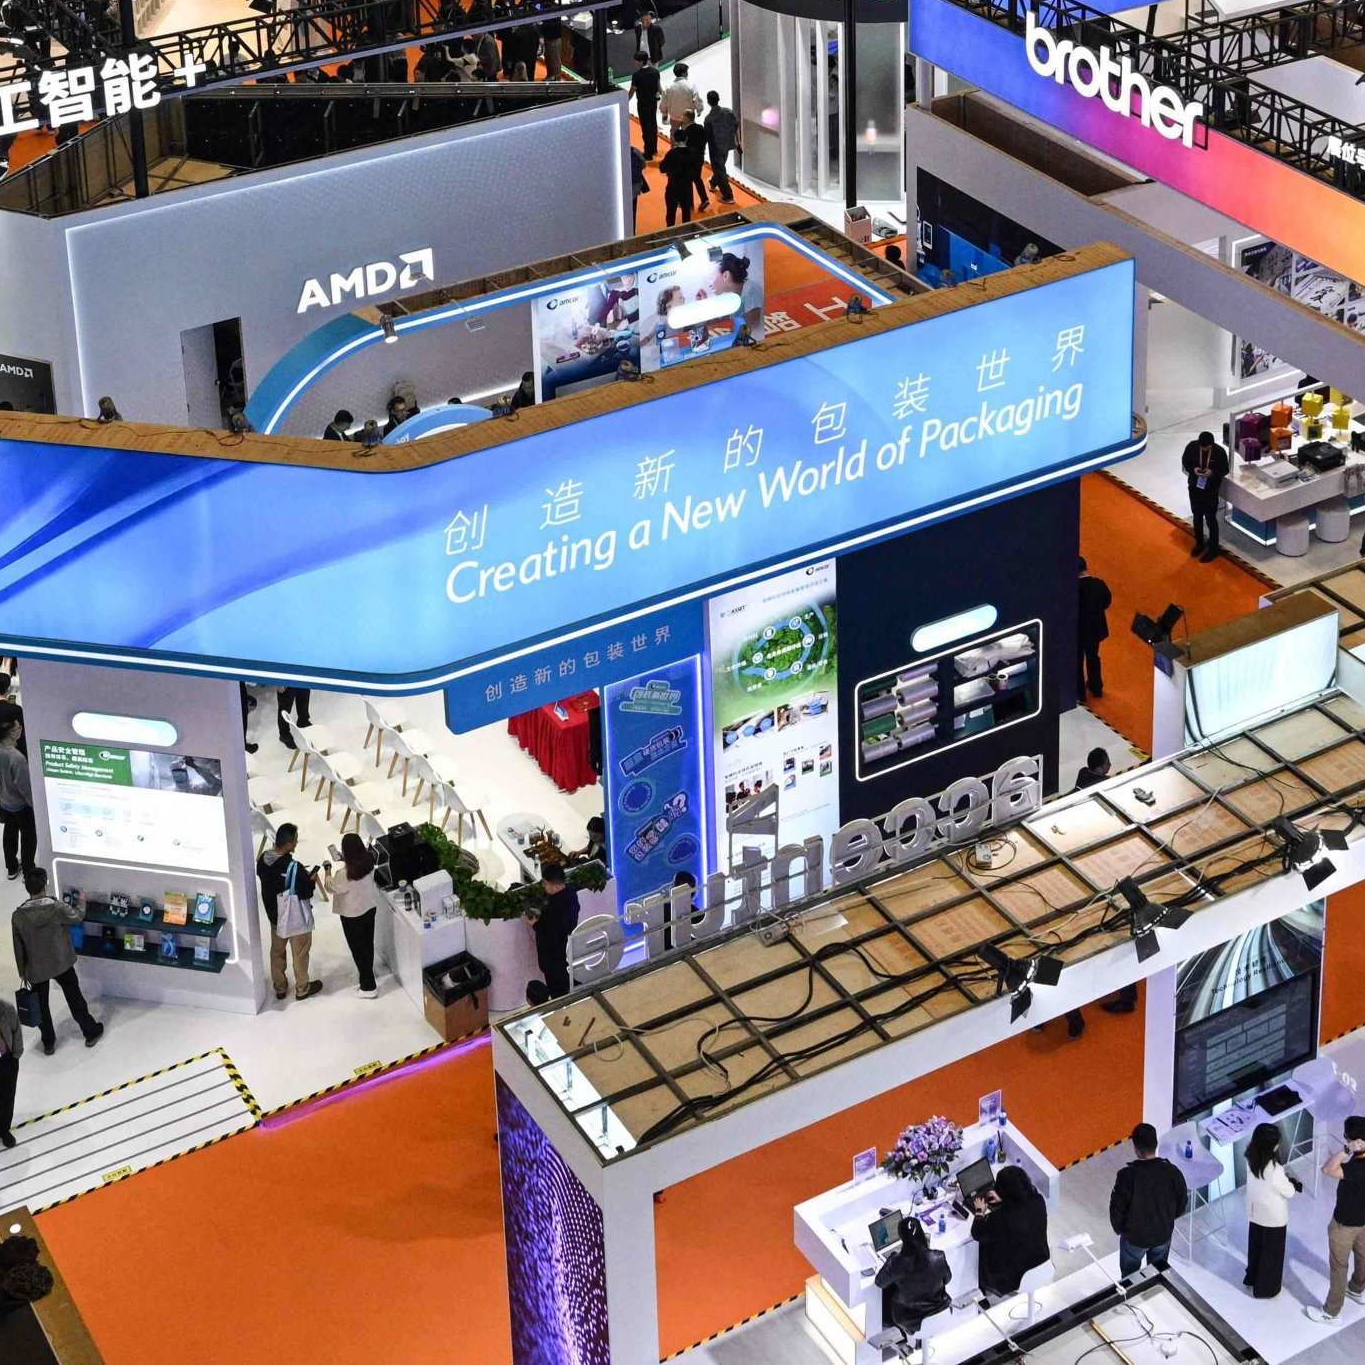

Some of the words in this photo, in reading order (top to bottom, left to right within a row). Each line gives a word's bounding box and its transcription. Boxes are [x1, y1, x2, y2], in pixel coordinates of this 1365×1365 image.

[1024, 7, 1205, 150] brother
[297, 260, 398, 313] AMD
[559, 295, 580, 308] amcor
[658, 269, 679, 281] amcor
[0, 363, 25, 377] AMD
[443, 323, 1086, 558] 创造新的包装世界
[446, 528, 618, 604] Creating
[627, 517, 652, 551] a
[662, 489, 747, 541] New
[759, 450, 868, 515] World
[875, 439, 911, 474] of
[919, 382, 1085, 463] Packaging
[484, 626, 673, 704] 创造新的包装世界
[44, 745, 86, 757] 产品安全管理
